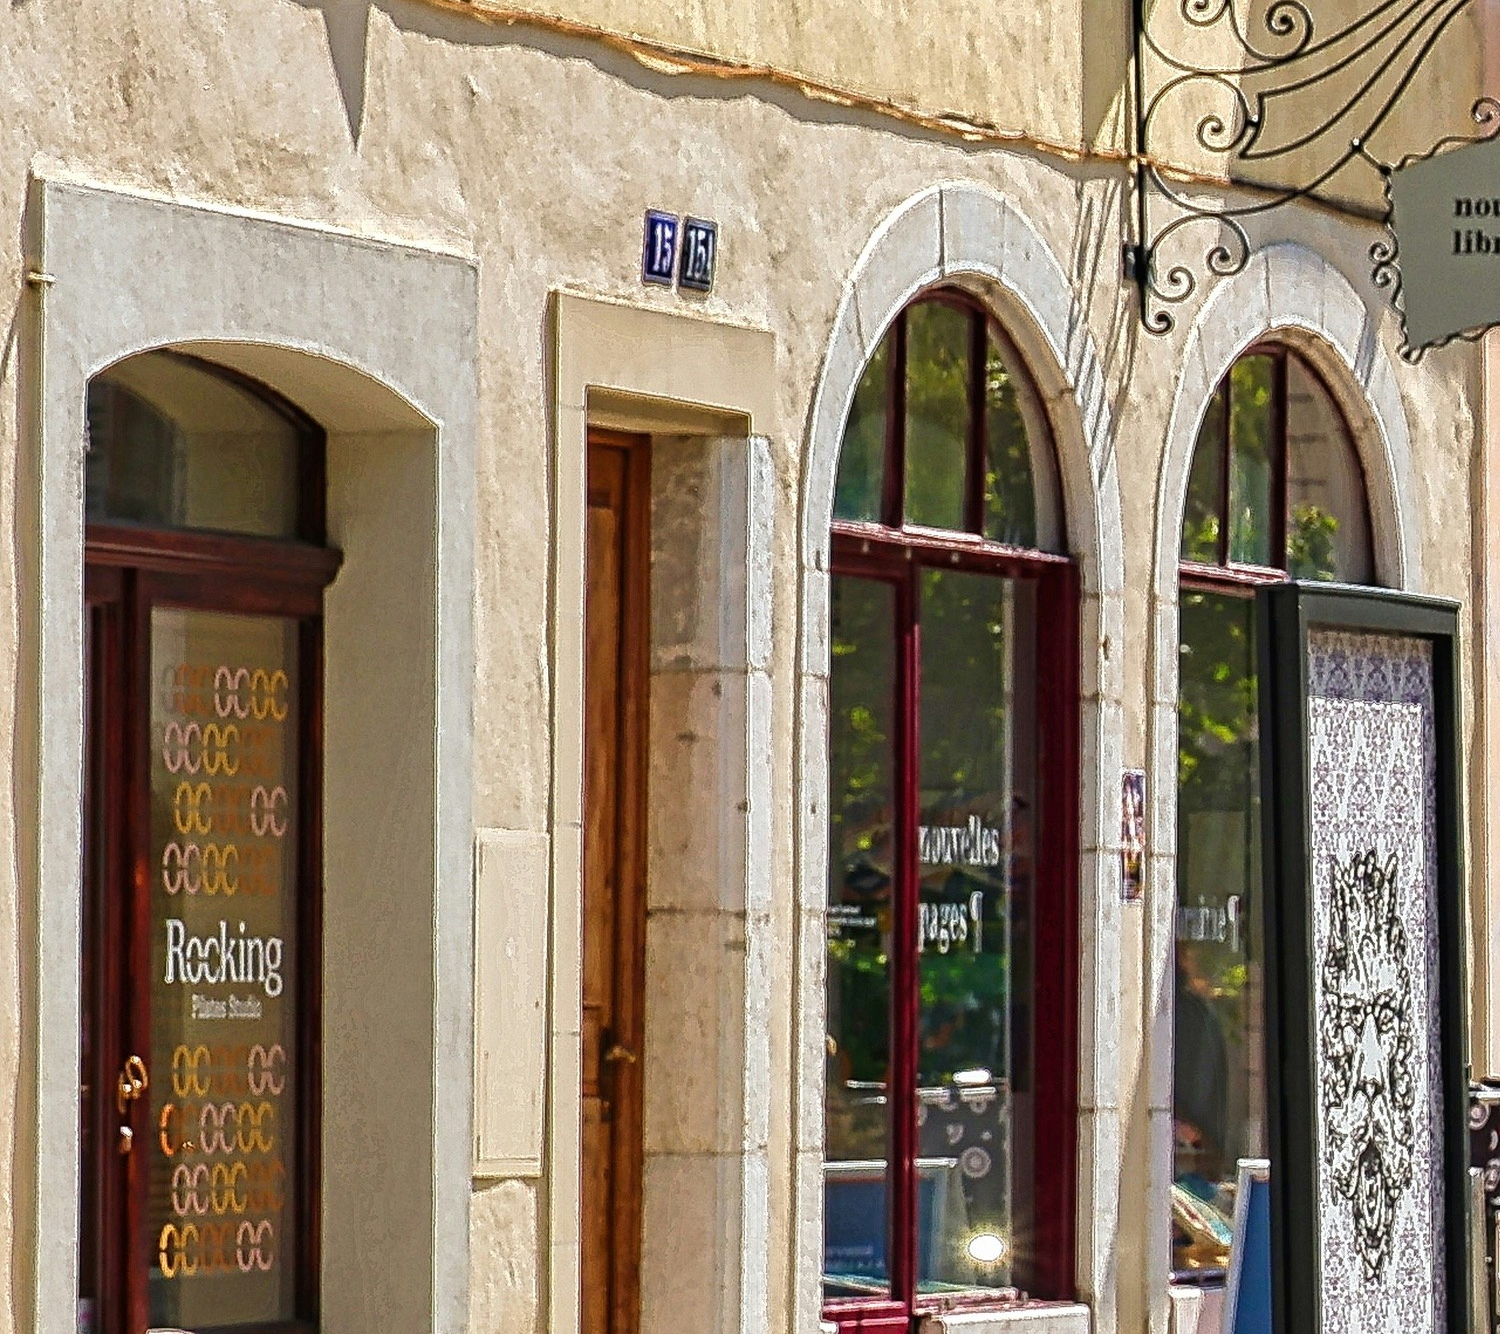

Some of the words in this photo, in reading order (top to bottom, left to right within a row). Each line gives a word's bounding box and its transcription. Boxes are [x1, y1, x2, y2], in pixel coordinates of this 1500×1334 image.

[917, 815, 999, 866] nouvelles
[917, 903, 968, 955] pages
[164, 918, 284, 998] Rocking
